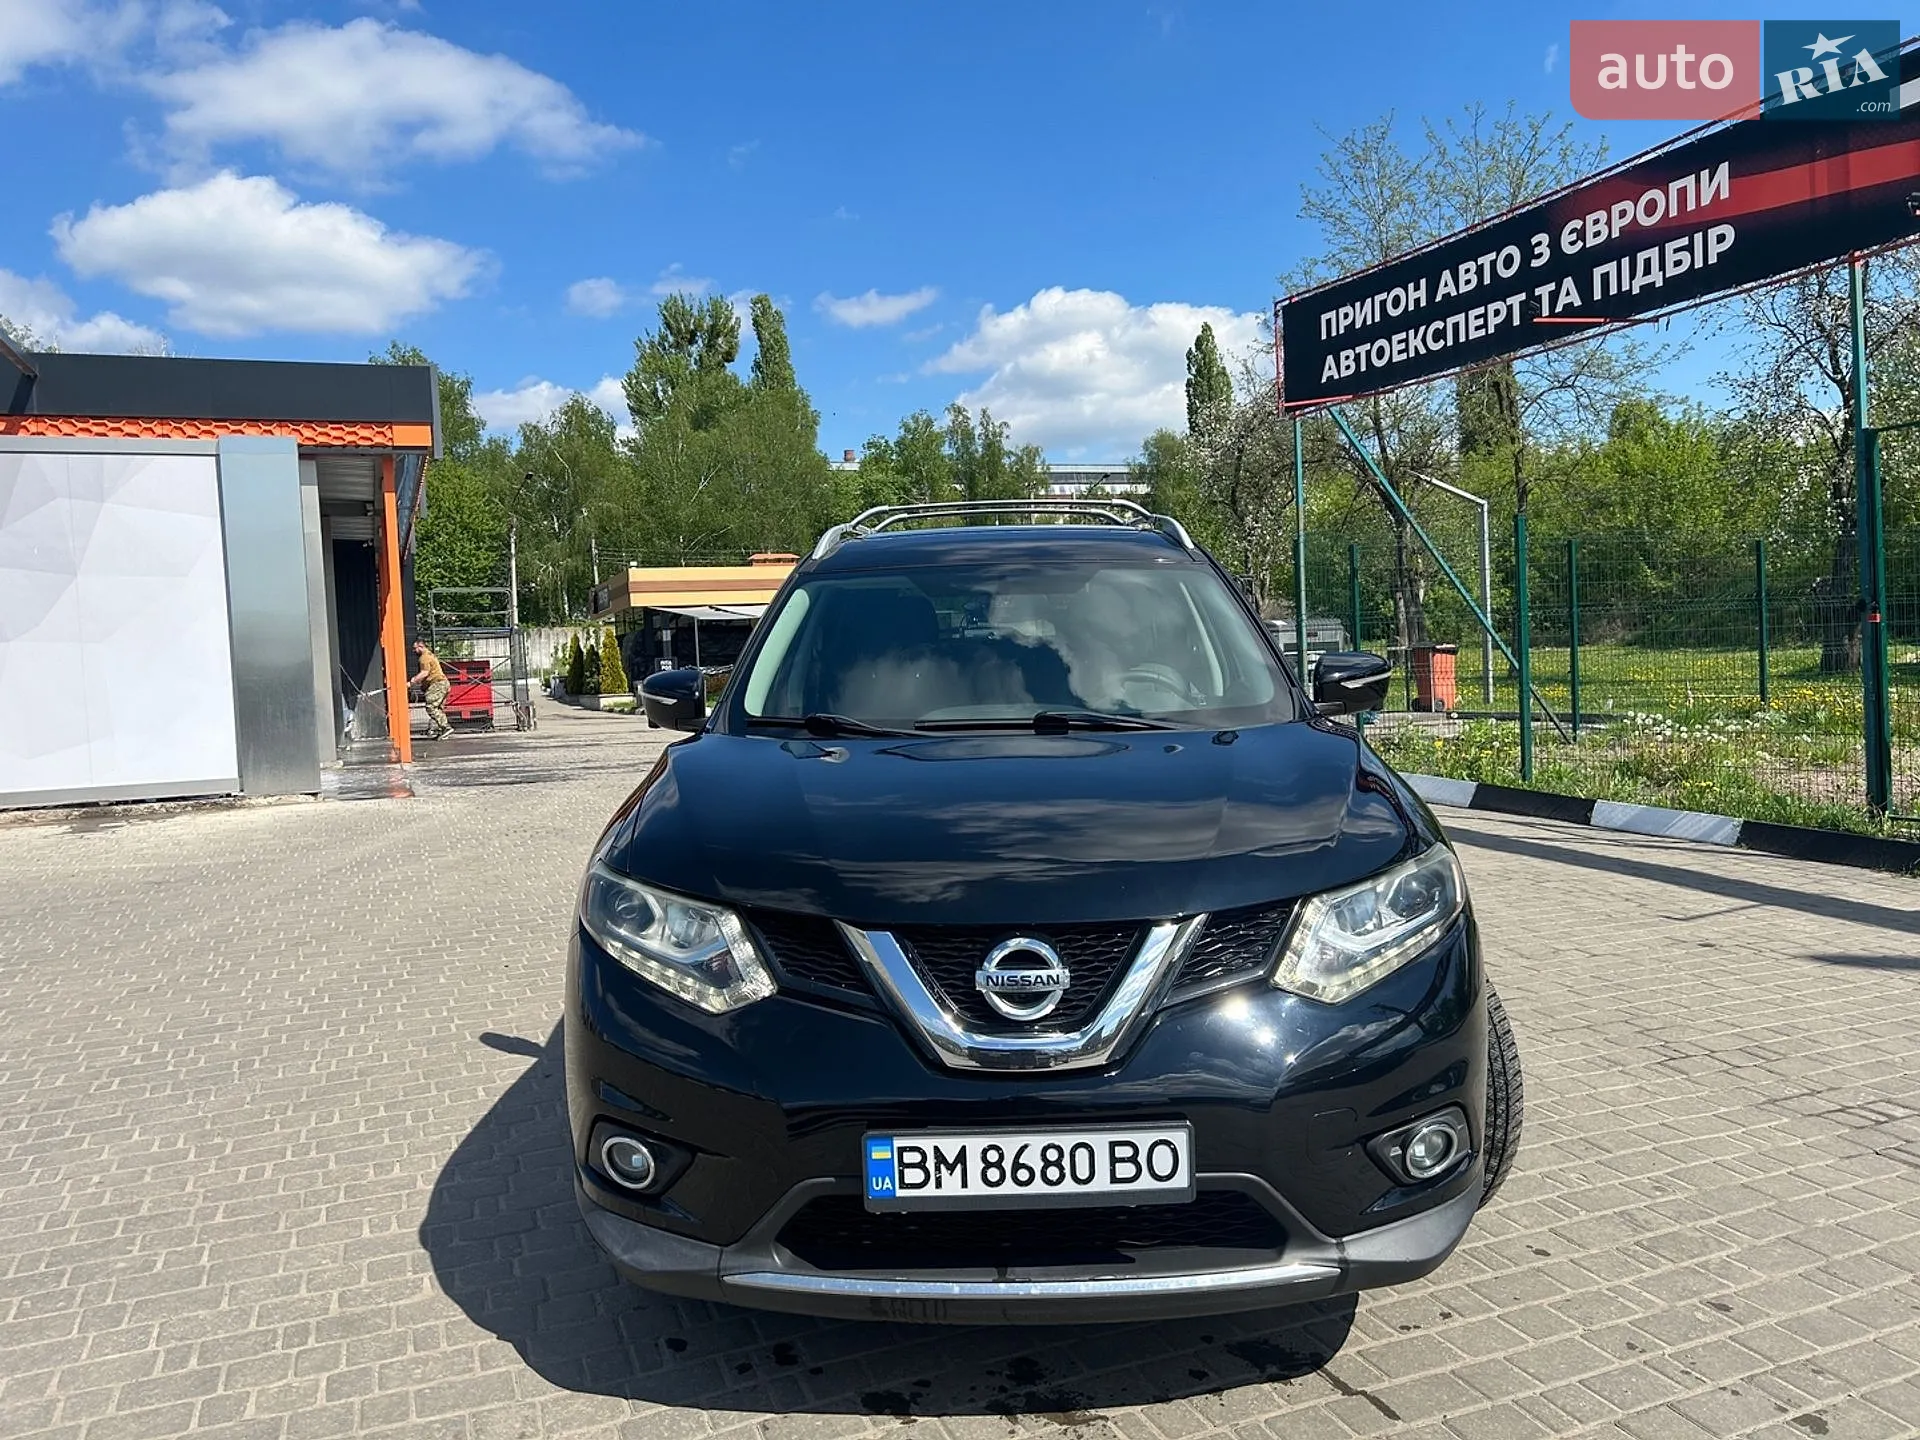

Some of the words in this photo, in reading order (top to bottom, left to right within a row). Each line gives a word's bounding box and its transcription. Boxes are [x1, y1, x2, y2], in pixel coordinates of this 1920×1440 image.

[1320, 278, 1427, 341] ПРИГОН
[1434, 245, 1522, 303] АВТО
[1530, 232, 1551, 268] З
[1560, 160, 1730, 255] ЄВРОПИ
[1320, 292, 1527, 384] АВТОЕКСПЕРТ
[1534, 276, 1583, 317] ТА
[1593, 223, 1736, 302] ПІДБІР
[985, 974, 1060, 987] NISSAN
[872, 1176, 893, 1191] UA
[897, 1144, 969, 1190] BM
[980, 1141, 1096, 1188] 8680
[1108, 1138, 1180, 1185] BO
